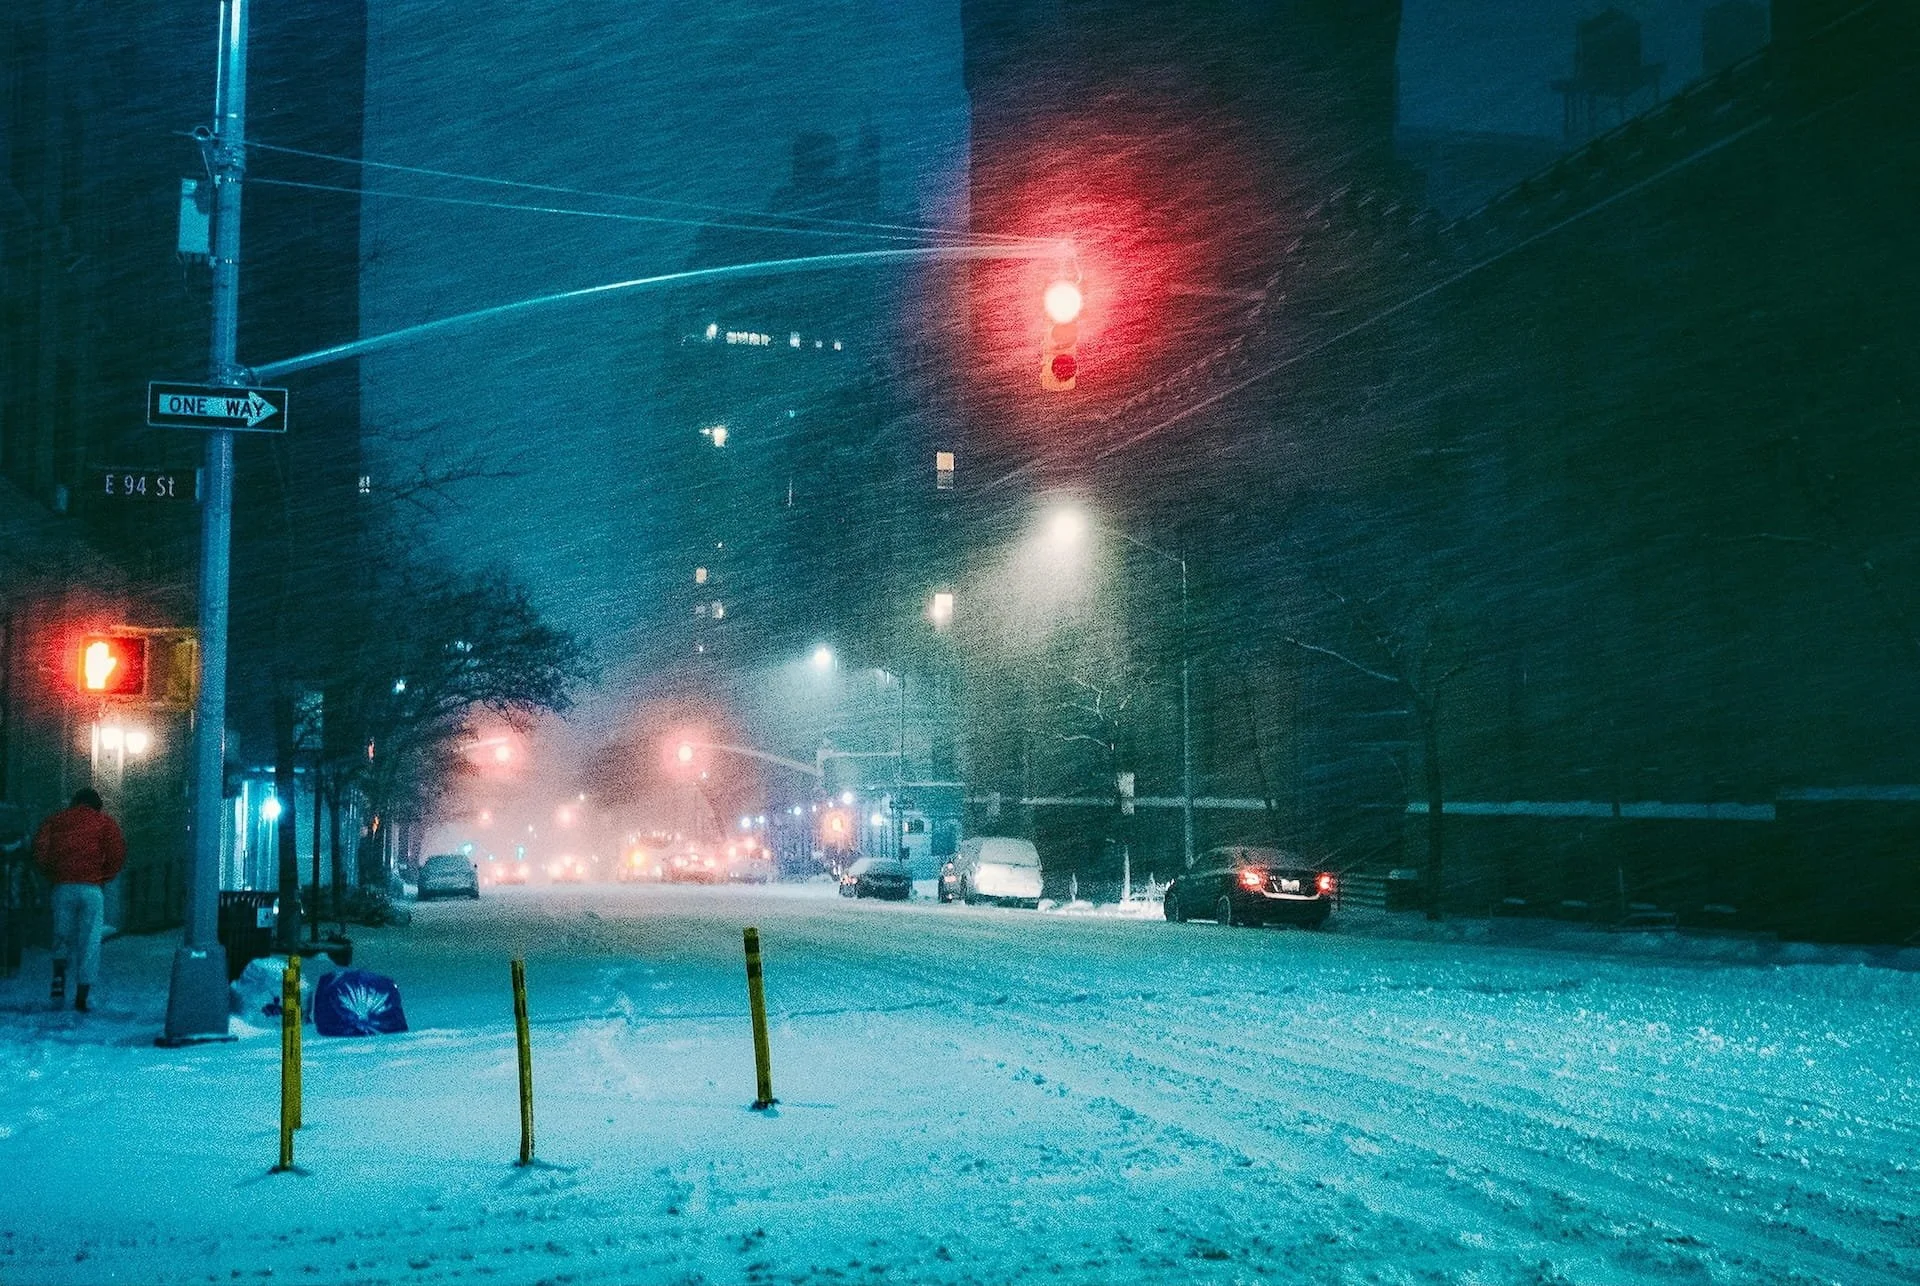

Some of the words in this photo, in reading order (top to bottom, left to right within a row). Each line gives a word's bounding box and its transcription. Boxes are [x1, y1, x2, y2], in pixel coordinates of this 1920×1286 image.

[169, 397, 207, 413] ONE
[226, 400, 266, 416] WAY
[105, 474, 114, 494] E
[124, 475, 147, 495] 94
[156, 476, 175, 497] St
